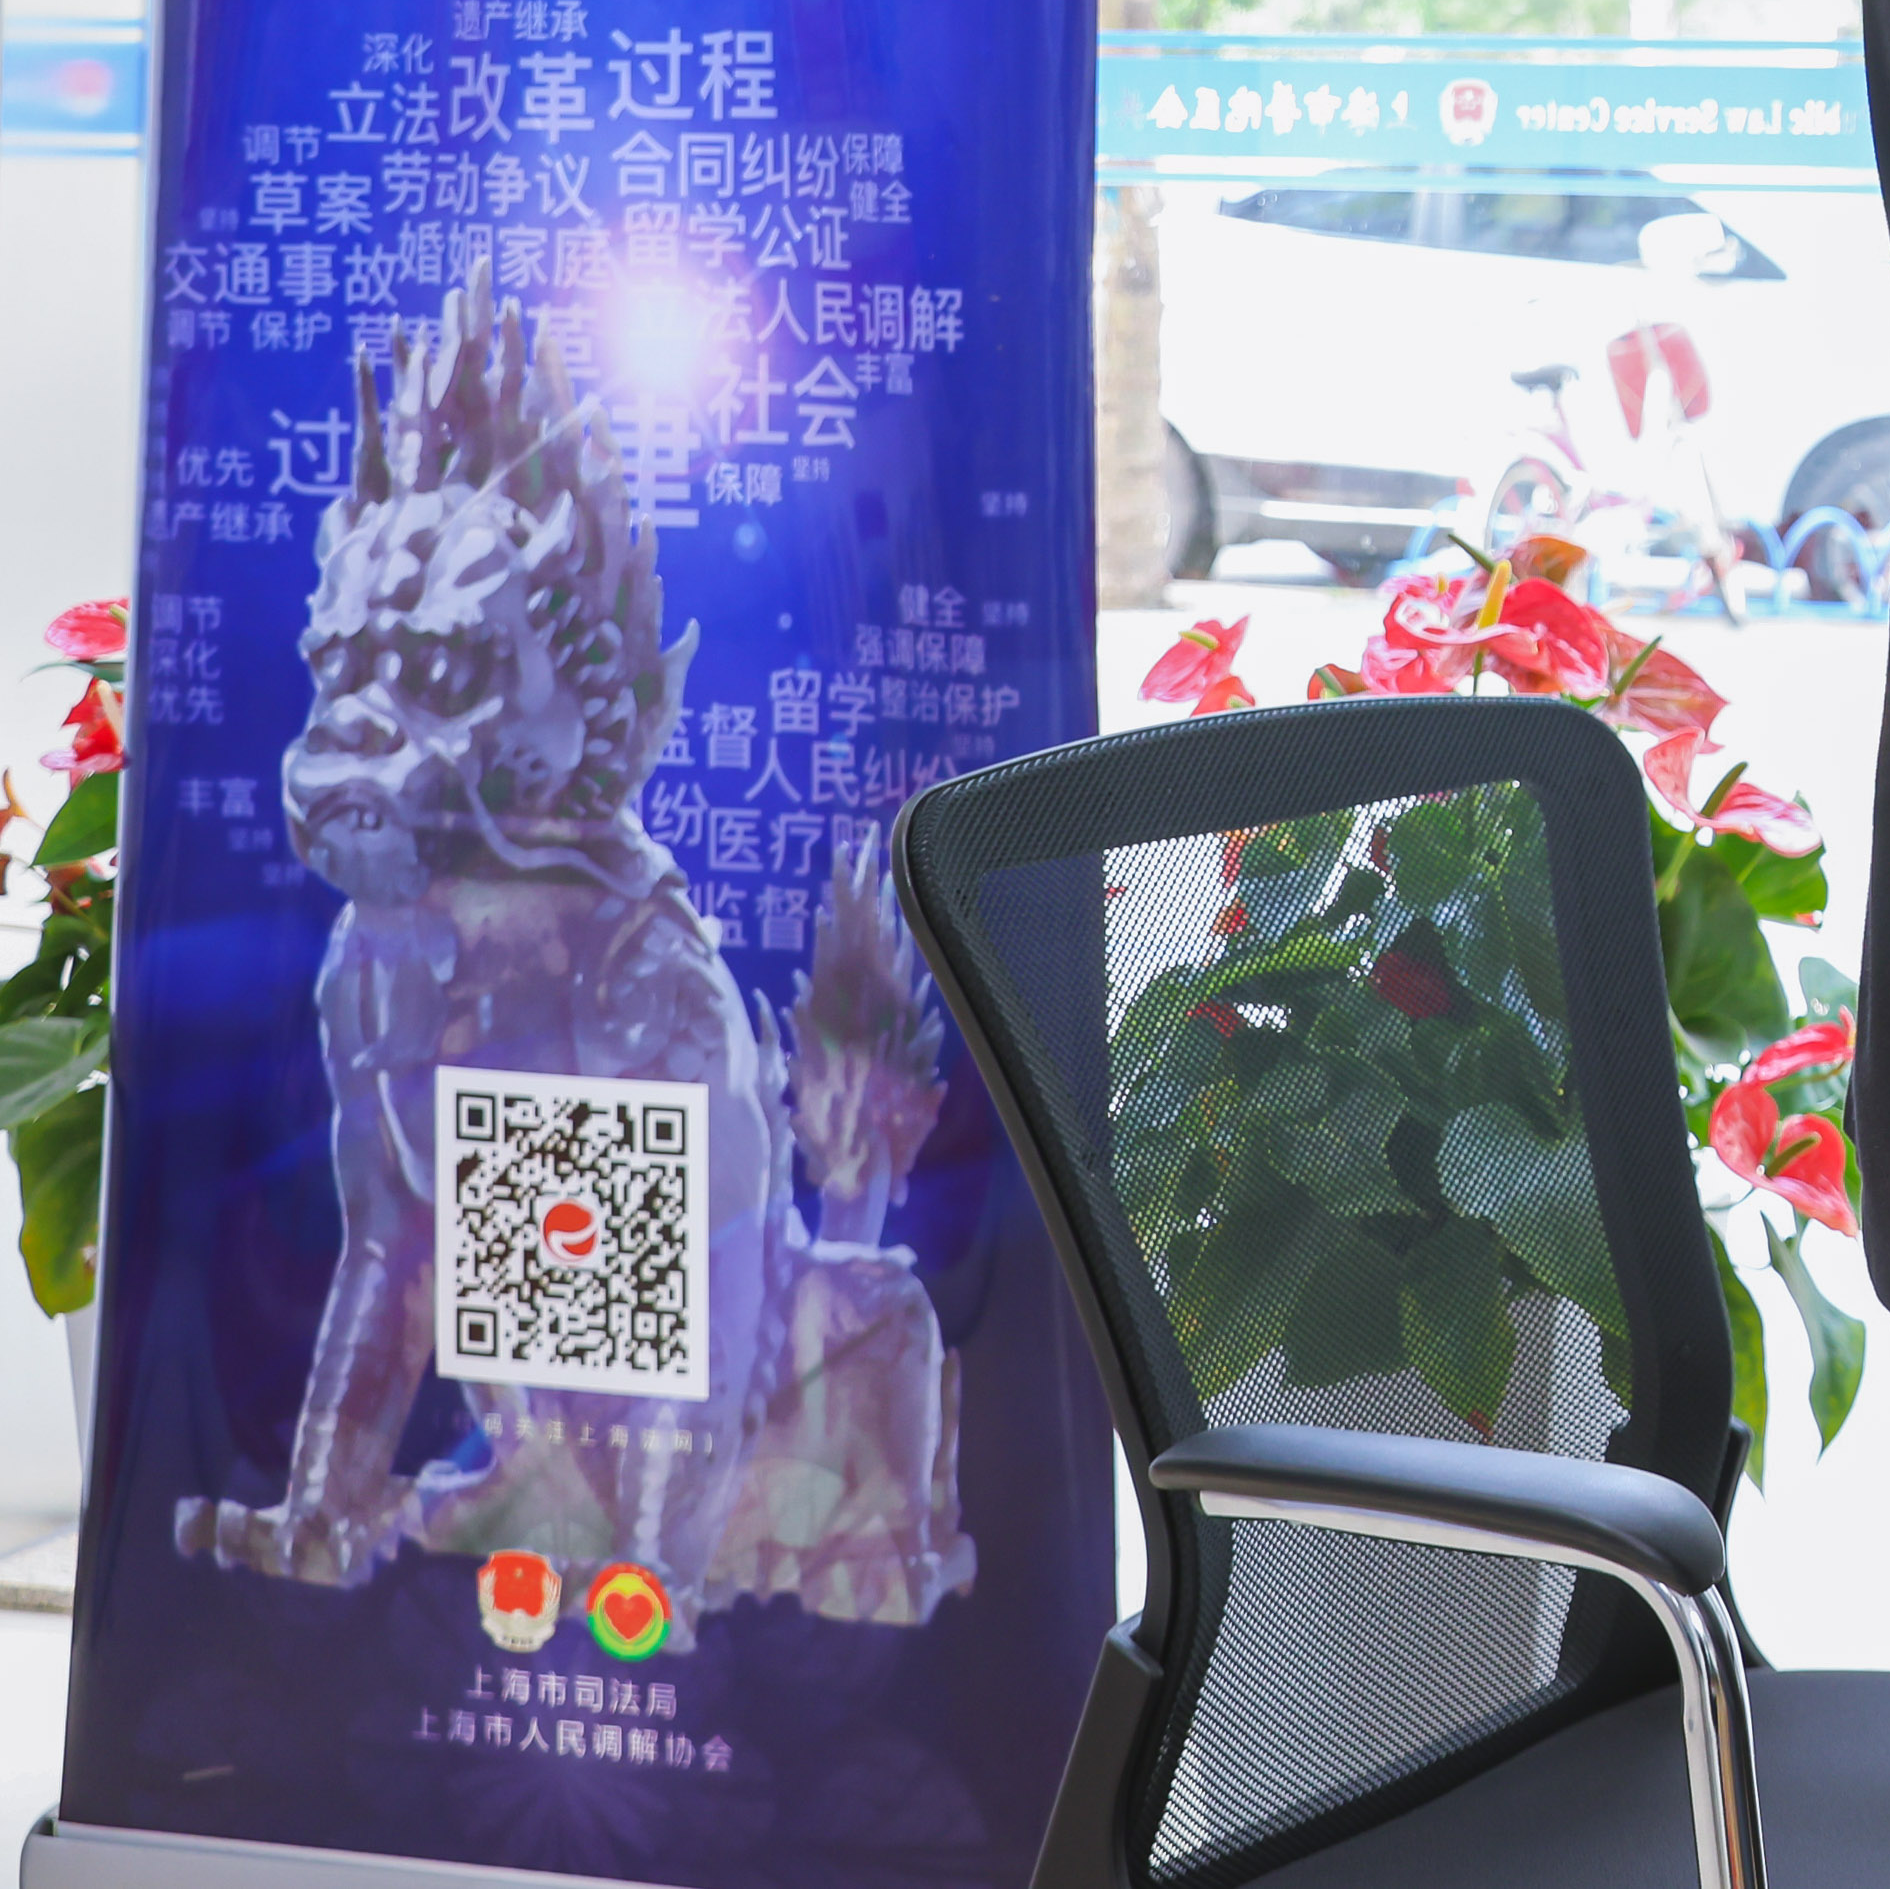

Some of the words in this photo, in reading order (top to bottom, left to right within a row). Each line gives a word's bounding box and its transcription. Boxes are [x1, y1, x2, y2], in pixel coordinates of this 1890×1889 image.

[362, 33, 434, 75] 深化
[449, 51, 595, 145] 改革
[605, 27, 779, 121] 过程
[242, 125, 322, 166] 调节
[326, 81, 440, 146] 立法
[248, 171, 374, 236] 草案
[382, 148, 596, 219] 劳动争议
[611, 129, 840, 200] 合同纠纷
[841, 132, 904, 176] 保障
[849, 180, 912, 224] 健全
[164, 241, 400, 307] 交通事故
[399, 219, 611, 291] 婚姻家庭
[623, 199, 852, 272] 留学公证
[250, 310, 333, 352] 保护
[757, 276, 965, 353] 人民调解
[706, 352, 860, 451] 社会
[854, 350, 916, 395] 丰富
[177, 447, 254, 489] 优先
[705, 461, 783, 507] 保障
[900, 583, 967, 630] 健全
[769, 667, 878, 738] 留学
[466, 1663, 678, 1722] 上海市司法局
[412, 1707, 734, 1773] 上海市人民调解协会
